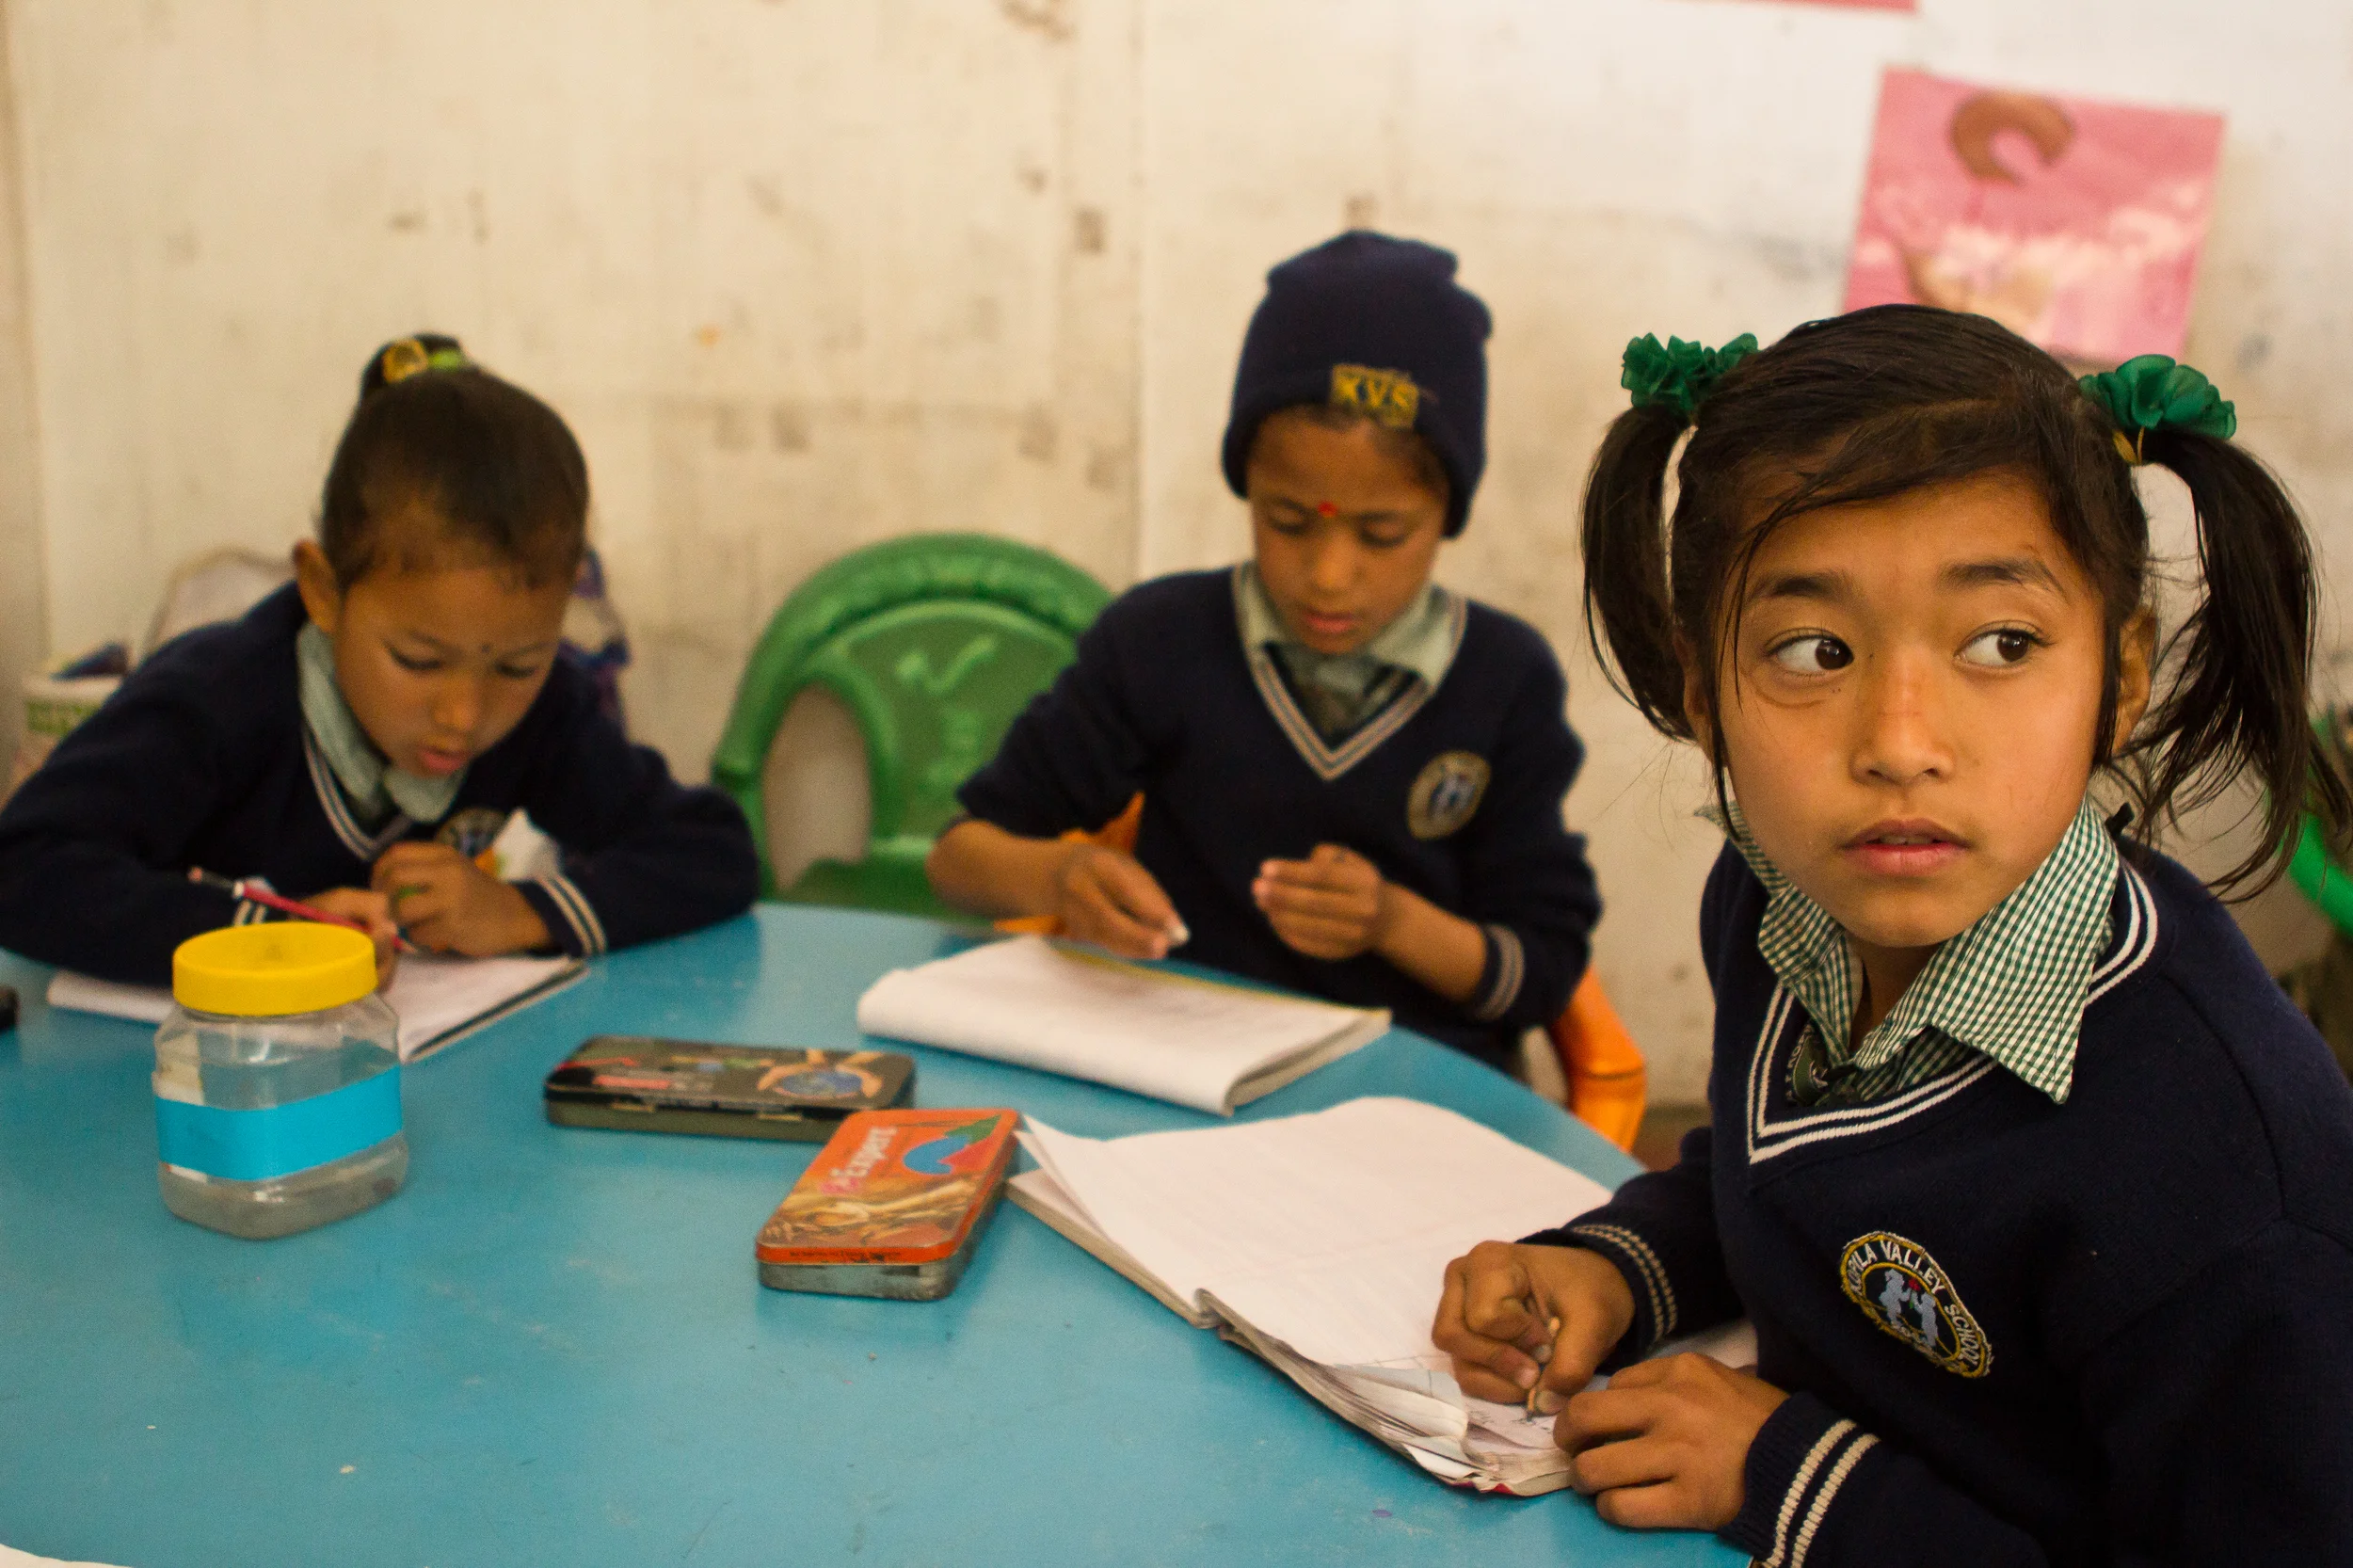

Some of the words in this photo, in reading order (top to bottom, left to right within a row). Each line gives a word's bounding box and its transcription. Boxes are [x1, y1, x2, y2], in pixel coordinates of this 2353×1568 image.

[1333, 369, 1418, 421] KVS
[1880, 1240, 1946, 1295] VALLEY
[1945, 1304, 1980, 1366] SCHOOL
